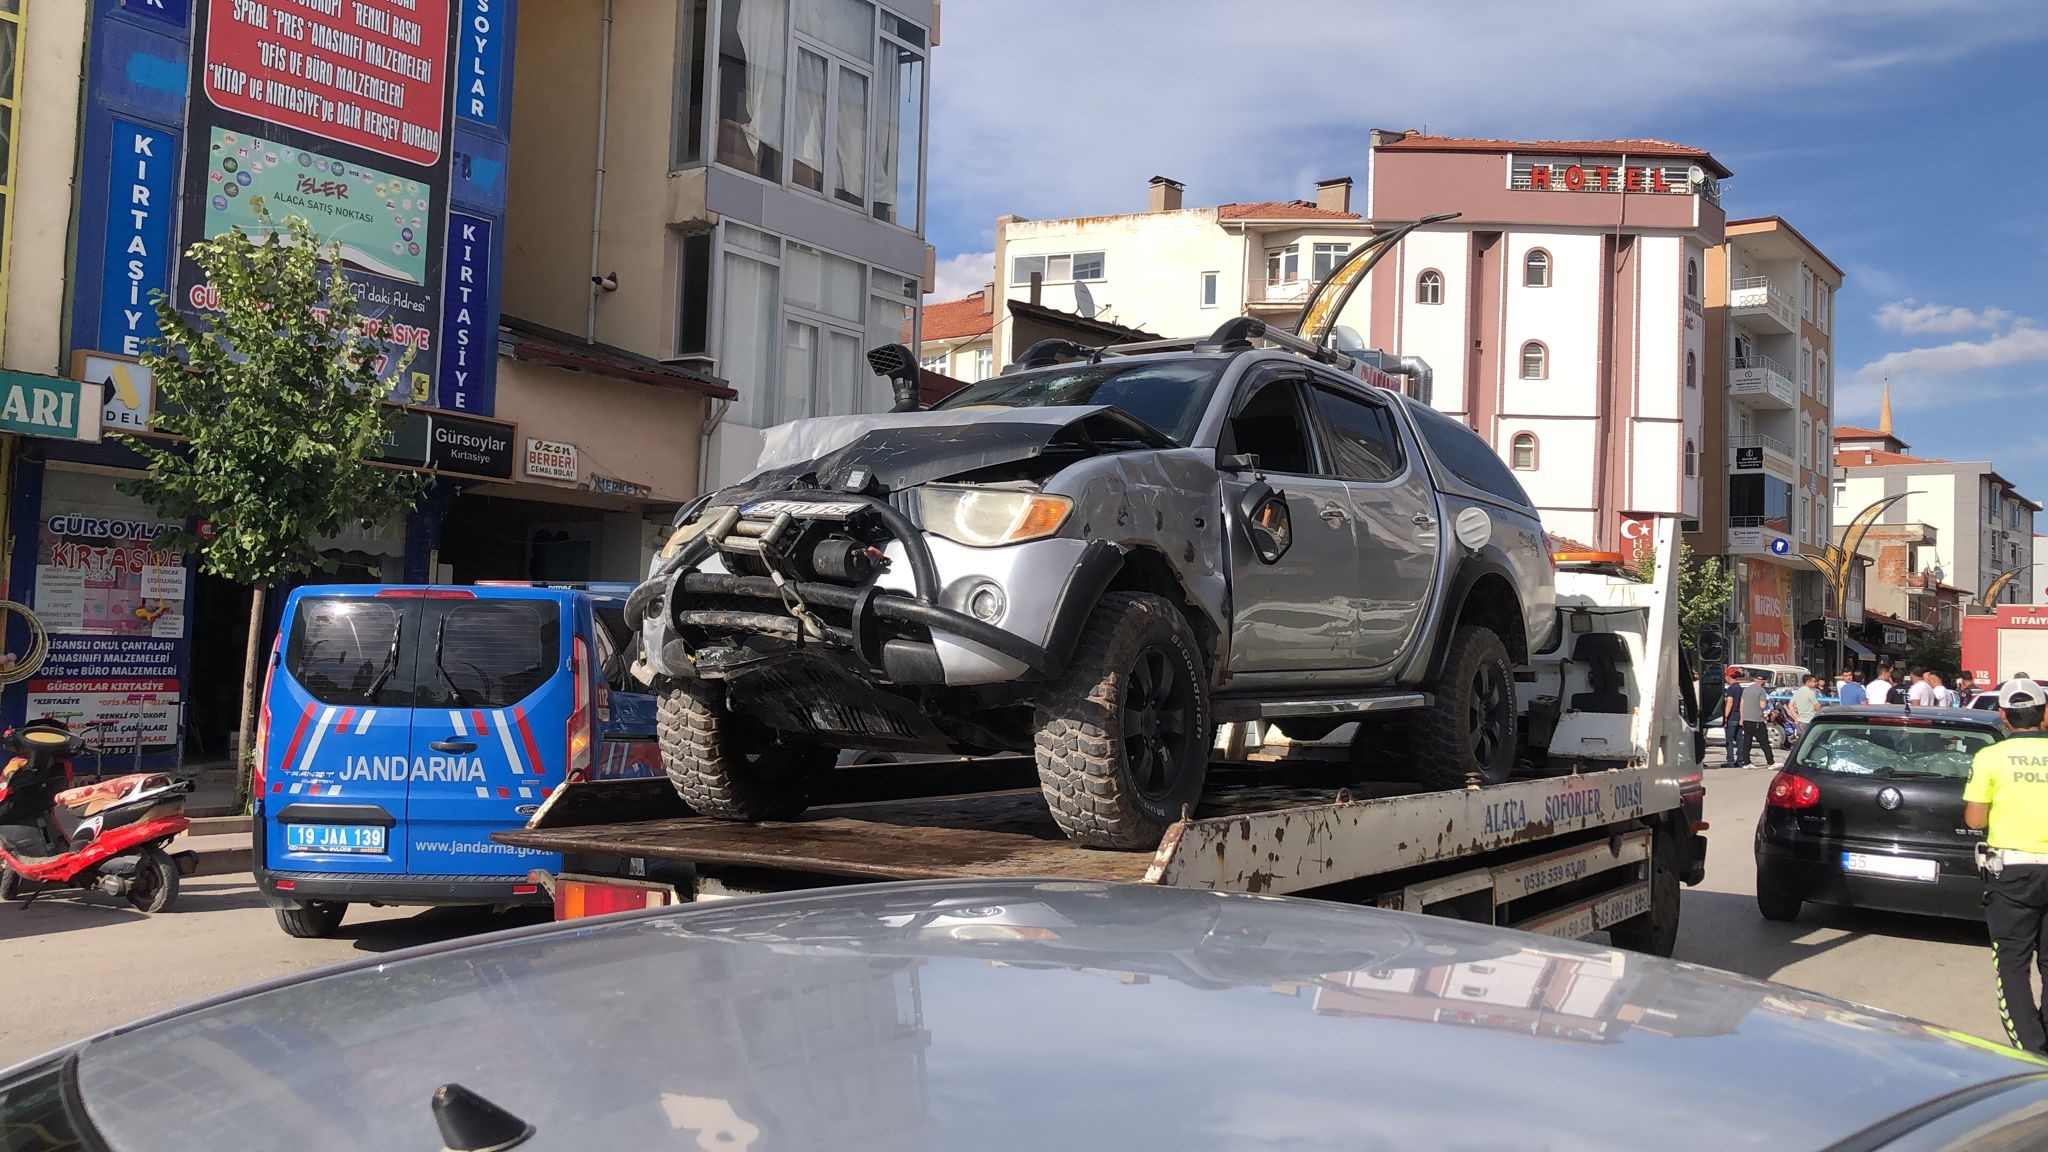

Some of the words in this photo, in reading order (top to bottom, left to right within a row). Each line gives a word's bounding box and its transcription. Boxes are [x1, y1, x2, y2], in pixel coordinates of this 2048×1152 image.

[392, 15, 422, 47] BASKI
[365, 40, 432, 84] MALZEMELERİ
[289, 50, 303, 77] VE
[305, 51, 333, 86] BÜRO
[335, 66, 405, 109] MALZEMELERİ
[250, 77, 263, 101] ve
[336, 102, 361, 131] DAİR
[364, 112, 400, 143] HERŞEY
[402, 121, 439, 154] BURADA
[1530, 164, 1671, 191] HOTEL
[273, 191, 305, 209] ALACA
[307, 201, 333, 216] SATIŞ
[335, 206, 374, 224] NOKTASI
[123, 134, 154, 356] KIRTASİYE
[454, 224, 476, 408] KIRTASİYE
[0, 384, 75, 429] ARI
[435, 427, 507, 452] Gürsoylar
[450, 449, 491, 464] Kırtasiye
[530, 465, 552, 475] CEMAL
[553, 468, 574, 477] BOLAT
[93, 641, 119, 650] OKUL
[122, 641, 174, 652] ÇANTALARI
[104, 652, 170, 663] MALZEMELERİ
[66, 668, 79, 676] ve
[81, 664, 109, 676] BÜRO
[111, 666, 177, 676] MALZEMELERİ
[1975, 670, 1989, 679] 112
[47, 680, 108, 691] GÜRSOYLAR
[111, 681, 165, 691] KIRTASİYE
[121, 724, 168, 733] ÇANALARI
[339, 755, 487, 782] JANDARMA
[298, 827, 315, 844] 19
[320, 828, 348, 845] JAA
[354, 829, 381, 846] 139
[415, 840, 554, 858] www.jandarma.gov.
